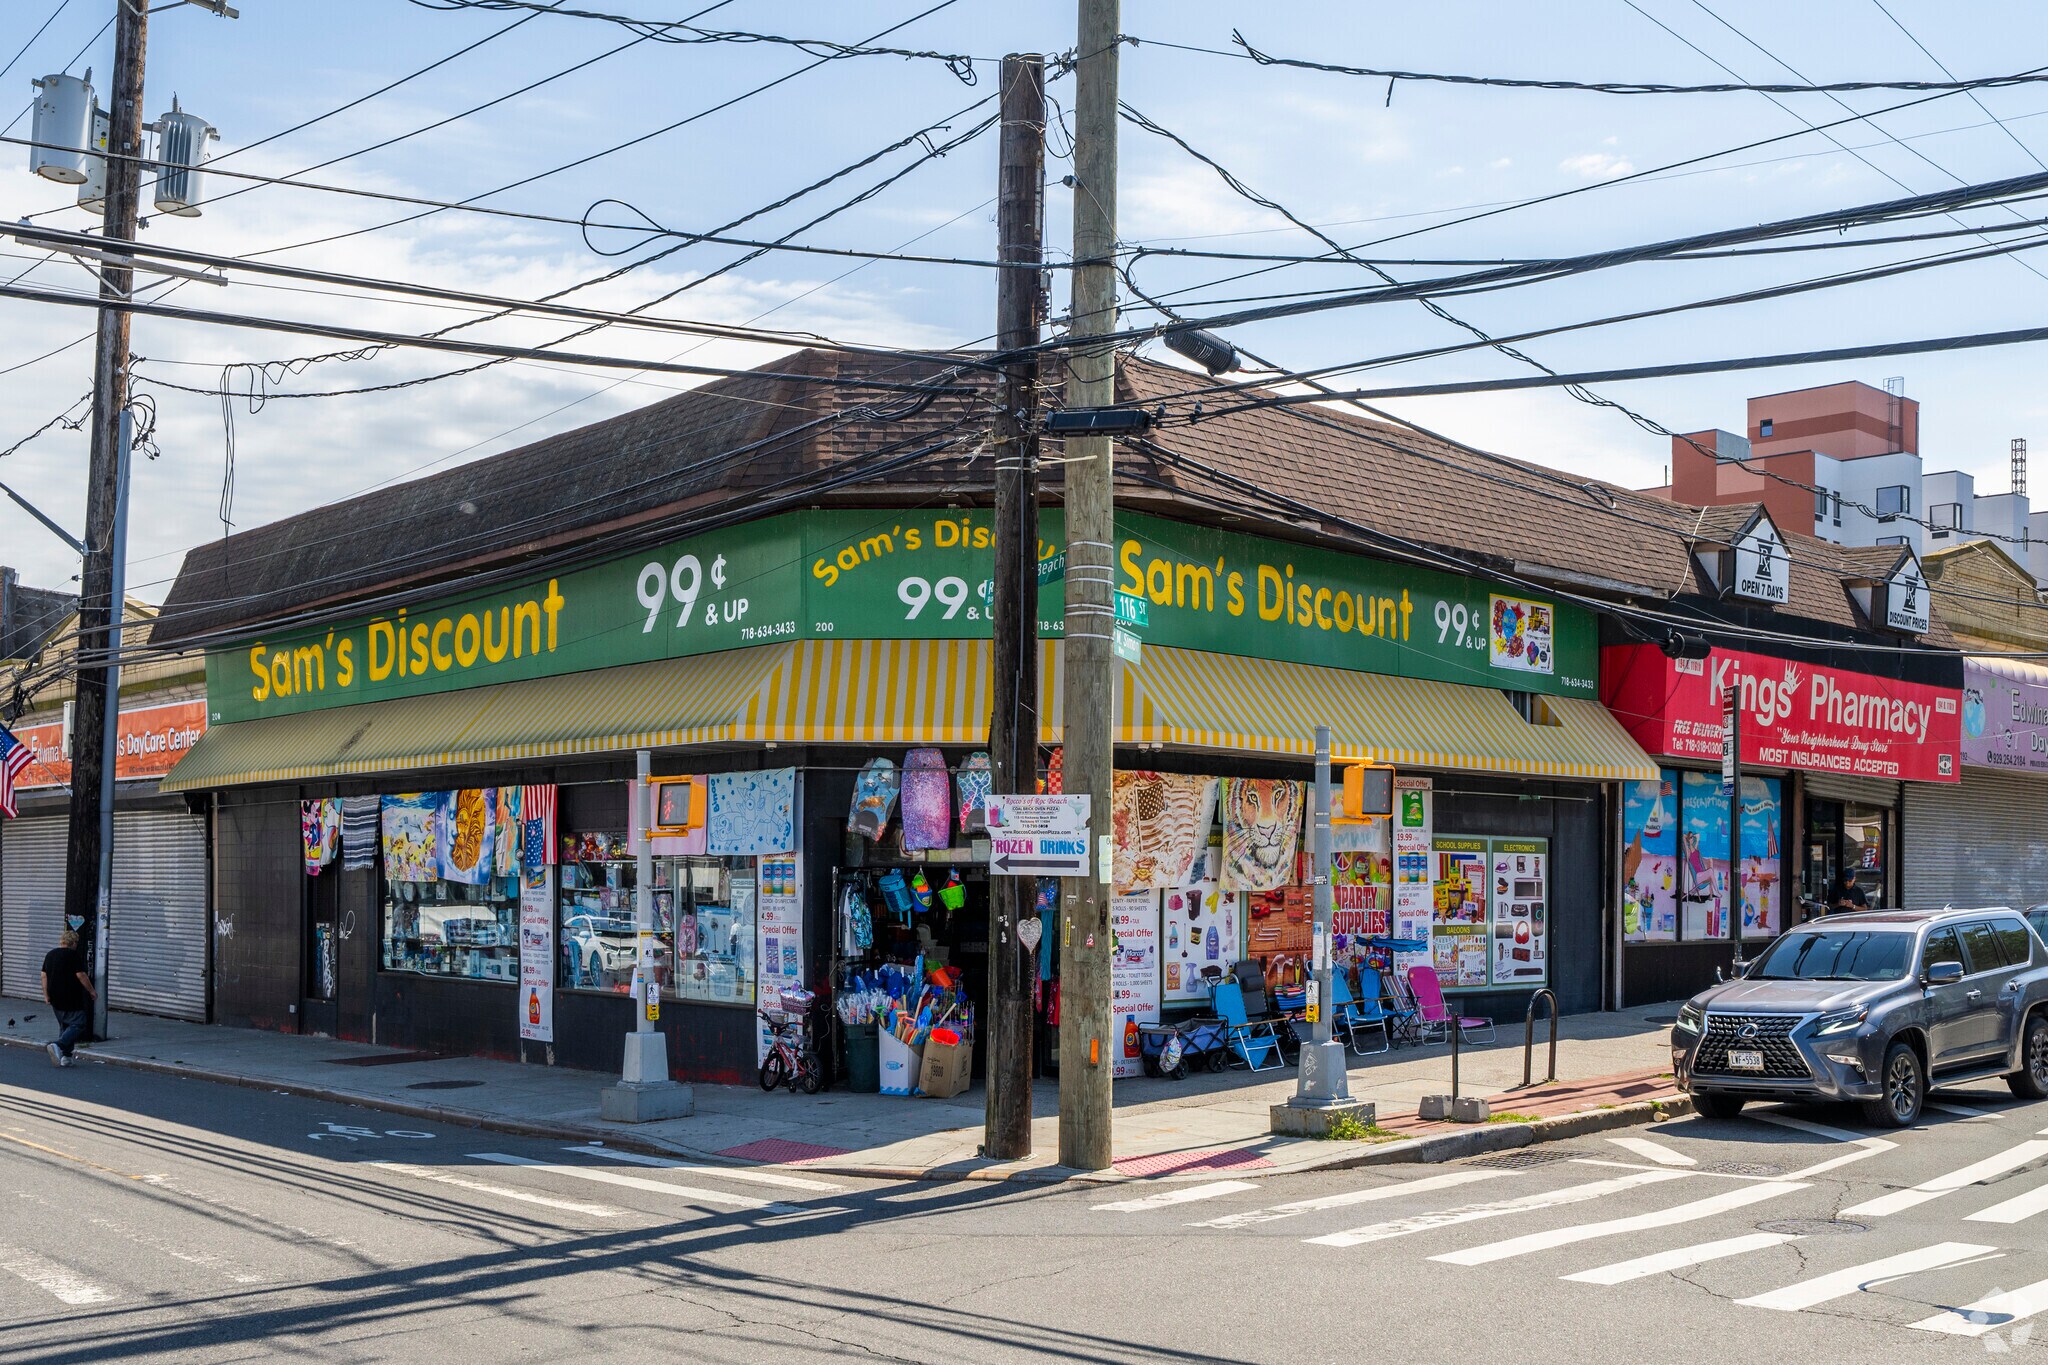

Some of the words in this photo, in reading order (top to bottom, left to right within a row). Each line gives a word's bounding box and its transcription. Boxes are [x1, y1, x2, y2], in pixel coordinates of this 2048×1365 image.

[812, 525, 922, 587] Sam's
[1119, 539, 1245, 616] Sam's
[1258, 563, 1414, 642] Discount
[1741, 579, 1760, 593] OPEN
[1761, 583, 1766, 595] 7
[1767, 583, 1784, 600] DAYS
[705, 603, 719, 626] &
[723, 598, 749, 623] UP
[1120, 595, 1136, 619] 116
[1139, 601, 1146, 615] St
[815, 622, 834, 632] 200
[1889, 611, 1911, 627] DISCOUNT
[1912, 614, 1928, 631] PRICES
[741, 621, 796, 640] 718-634-3433
[250, 627, 354, 702] Sam's
[368, 578, 565, 682] Discount
[1465, 635, 1473, 649] &
[1474, 637, 1487, 651] UP
[1560, 676, 1594, 690] 718-634-3433
[1810, 673, 1931, 744] Pharmacy
[1673, 719, 1692, 735] FREE
[1692, 721, 1724, 739] DELIVERY
[128, 730, 166, 758] DayCare
[168, 726, 201, 750] Center
[1685, 738, 1723, 755] 718-318-0300
[1759, 747, 1789, 764] MOST
[1791, 750, 1851, 770] INSURANCES
[1853, 757, 1899, 775] ACCEPTED
[1396, 779, 1414, 788] Special
[1415, 780, 1428, 788] Offer
[1006, 797, 1026, 805] Rocco's
[1047, 796, 1068, 805] Beach
[1397, 833, 1413, 841] 19.99
[1040, 839, 1086, 855] DRINKS
[1397, 843, 1416, 852] Special
[1416, 844, 1429, 852] Offer
[1435, 841, 1457, 849] SCHOOL
[1457, 842, 1481, 850] SUPPLIES
[1503, 844, 1536, 852] ELECTRONICS
[1341, 886, 1378, 910] PARTY
[761, 911, 774, 921] 4.99
[1398, 910, 1415, 918] Special
[1416, 909, 1429, 917] Offer
[762, 924, 781, 935] Special
[782, 926, 798, 935] Offer
[1332, 910, 1386, 935] SUPPLIES
[1446, 926, 1471, 934] BALOONS
[1117, 929, 1135, 938] pecial
[1136, 928, 1154, 938] Offer
[523, 978, 537, 986] Special
[761, 986, 773, 995] 7.99
[1113, 1004, 1135, 1015] Special
[1137, 1003, 1153, 1012] Offer
